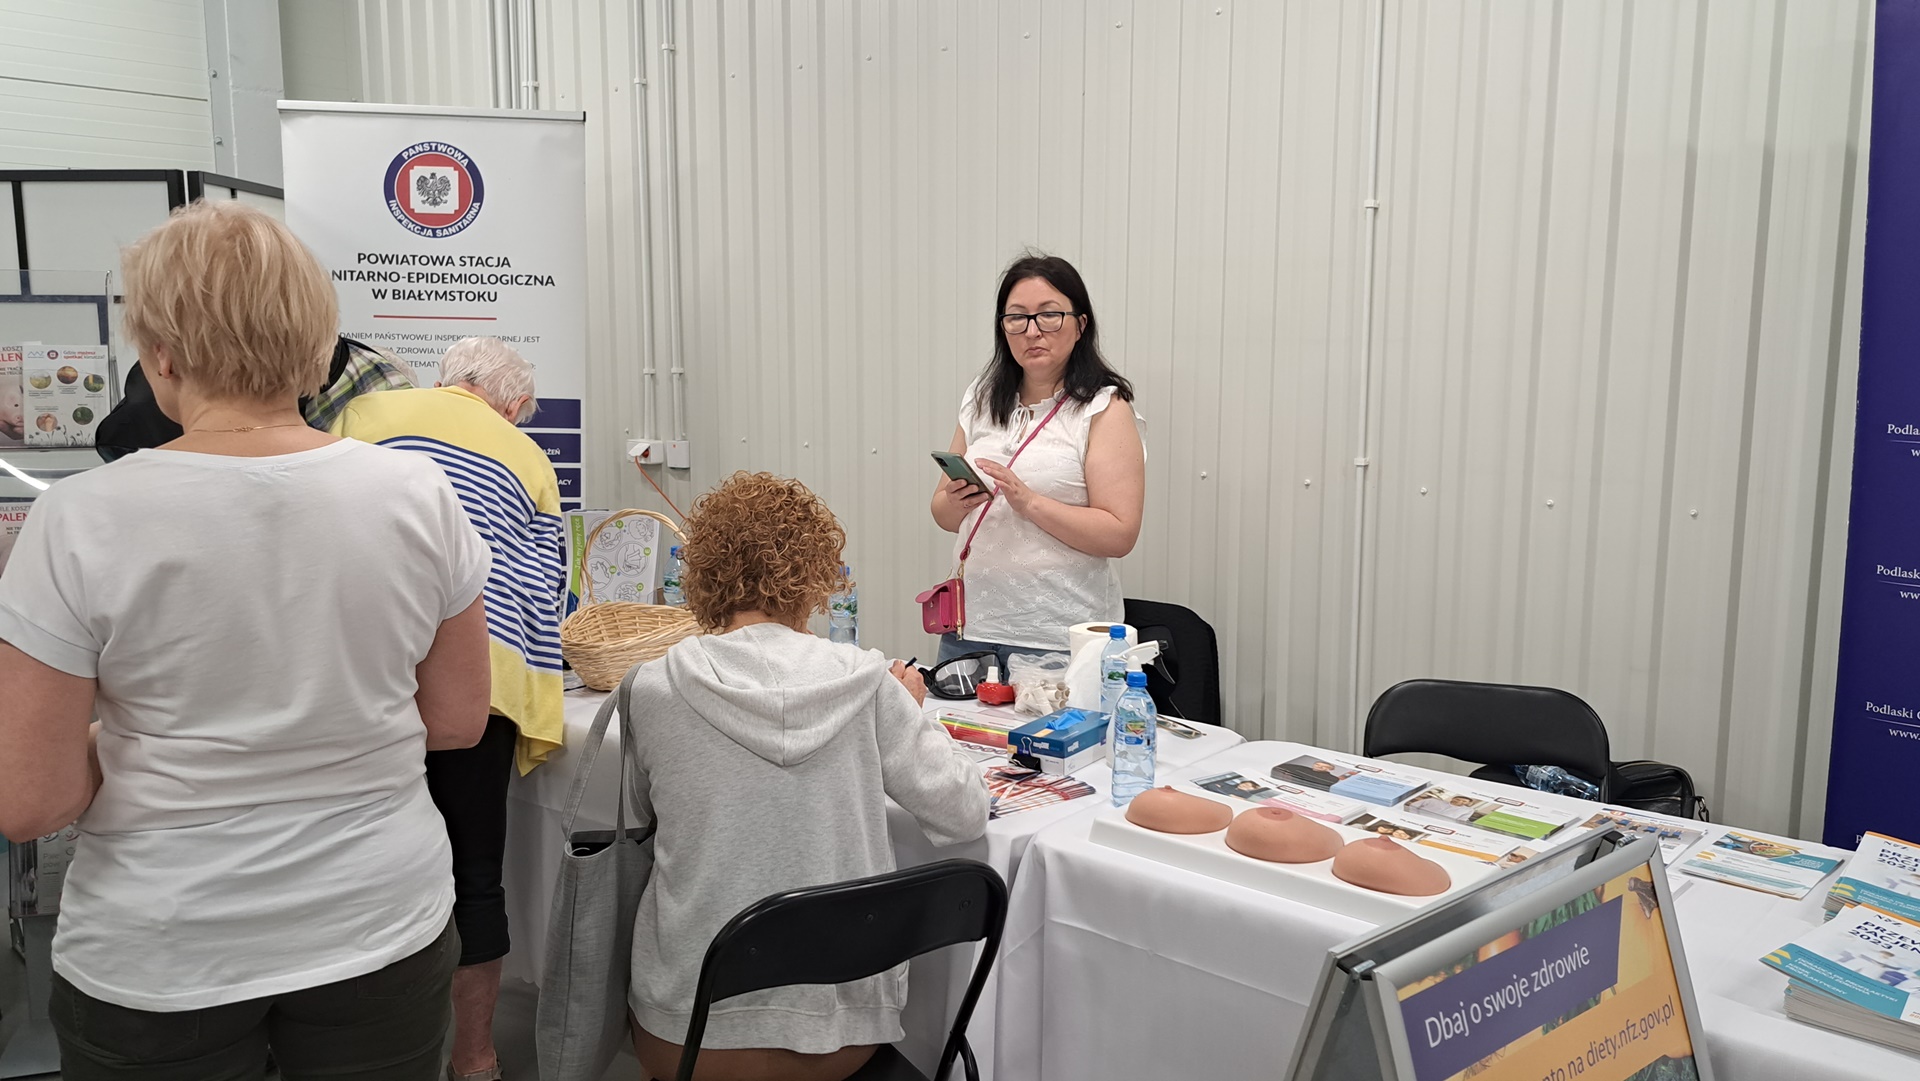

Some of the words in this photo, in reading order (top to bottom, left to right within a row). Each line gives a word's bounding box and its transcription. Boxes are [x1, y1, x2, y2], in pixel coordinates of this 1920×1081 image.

[401, 142, 469, 168] PAŃSTWOWA
[388, 199, 433, 237] INSPEKCJA
[436, 202, 481, 237] SANITARNA
[357, 252, 455, 267] POWIATOWA
[459, 255, 511, 268] STACJA
[332, 269, 555, 287] NITARNO-EPIDEMIOLOGICZNA
[372, 288, 388, 300] W
[392, 288, 498, 303] BIAŁYMSTOKU
[374, 331, 433, 341] PAŃSTWOWEJ
[1876, 564, 1920, 580] Podlask
[1865, 701, 1913, 719] Podlaski
[1877, 858, 1917, 872] 2023
[1848, 930, 1893, 950] 2023
[1424, 997, 1470, 1049] Dbaj
[1470, 1002, 1482, 1024] o
[1485, 974, 1530, 1018] swoje
[1531, 943, 1591, 993] zdrowie
[1567, 1056, 1585, 1080] na
[1586, 995, 1676, 1067] diety.nfz.gov.pl
